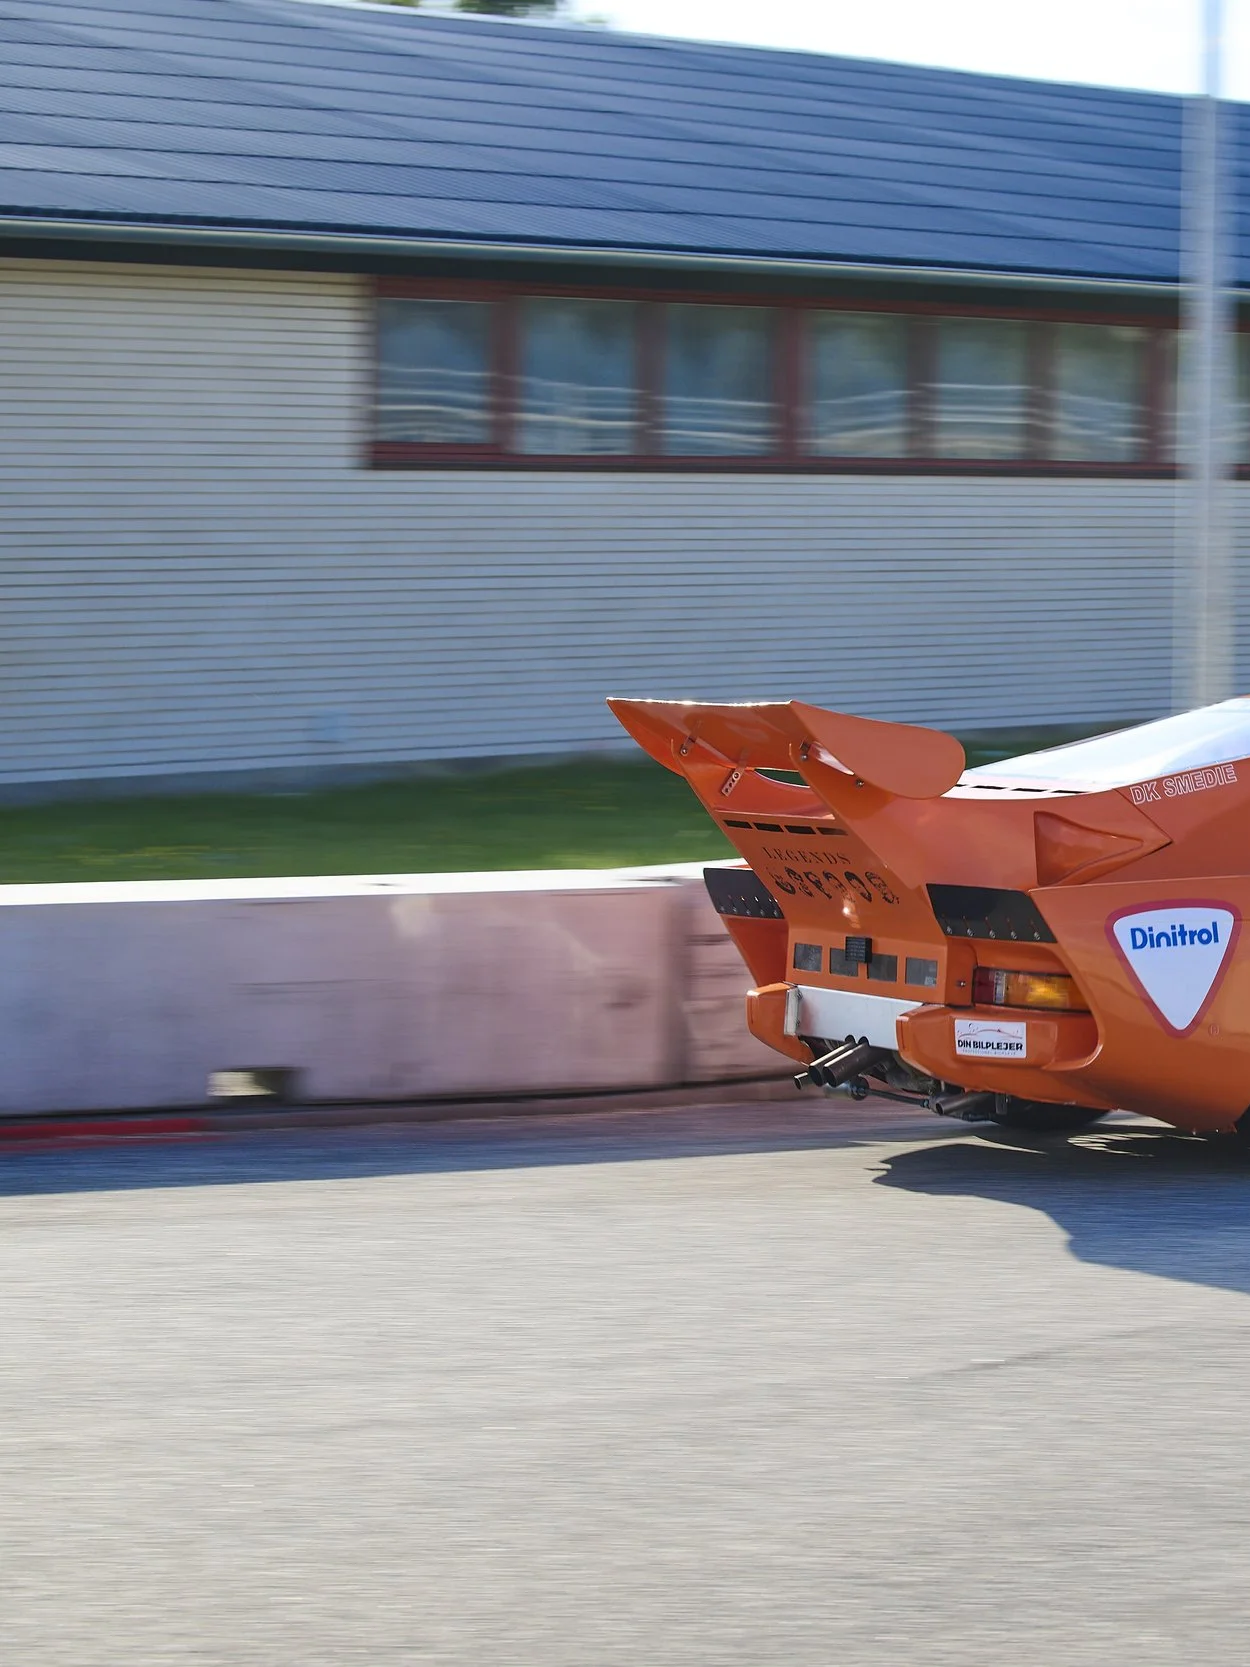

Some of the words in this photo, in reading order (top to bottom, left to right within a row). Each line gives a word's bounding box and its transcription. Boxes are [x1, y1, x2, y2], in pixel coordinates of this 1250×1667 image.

[1130, 782, 1162, 805] DK
[1162, 764, 1238, 797] SMEDIE
[762, 847, 851, 865] LEGENDS
[1130, 921, 1219, 950] Dinitrol
[957, 1039, 972, 1049] DIN
[972, 1041, 1023, 1051] BILPLEJER
